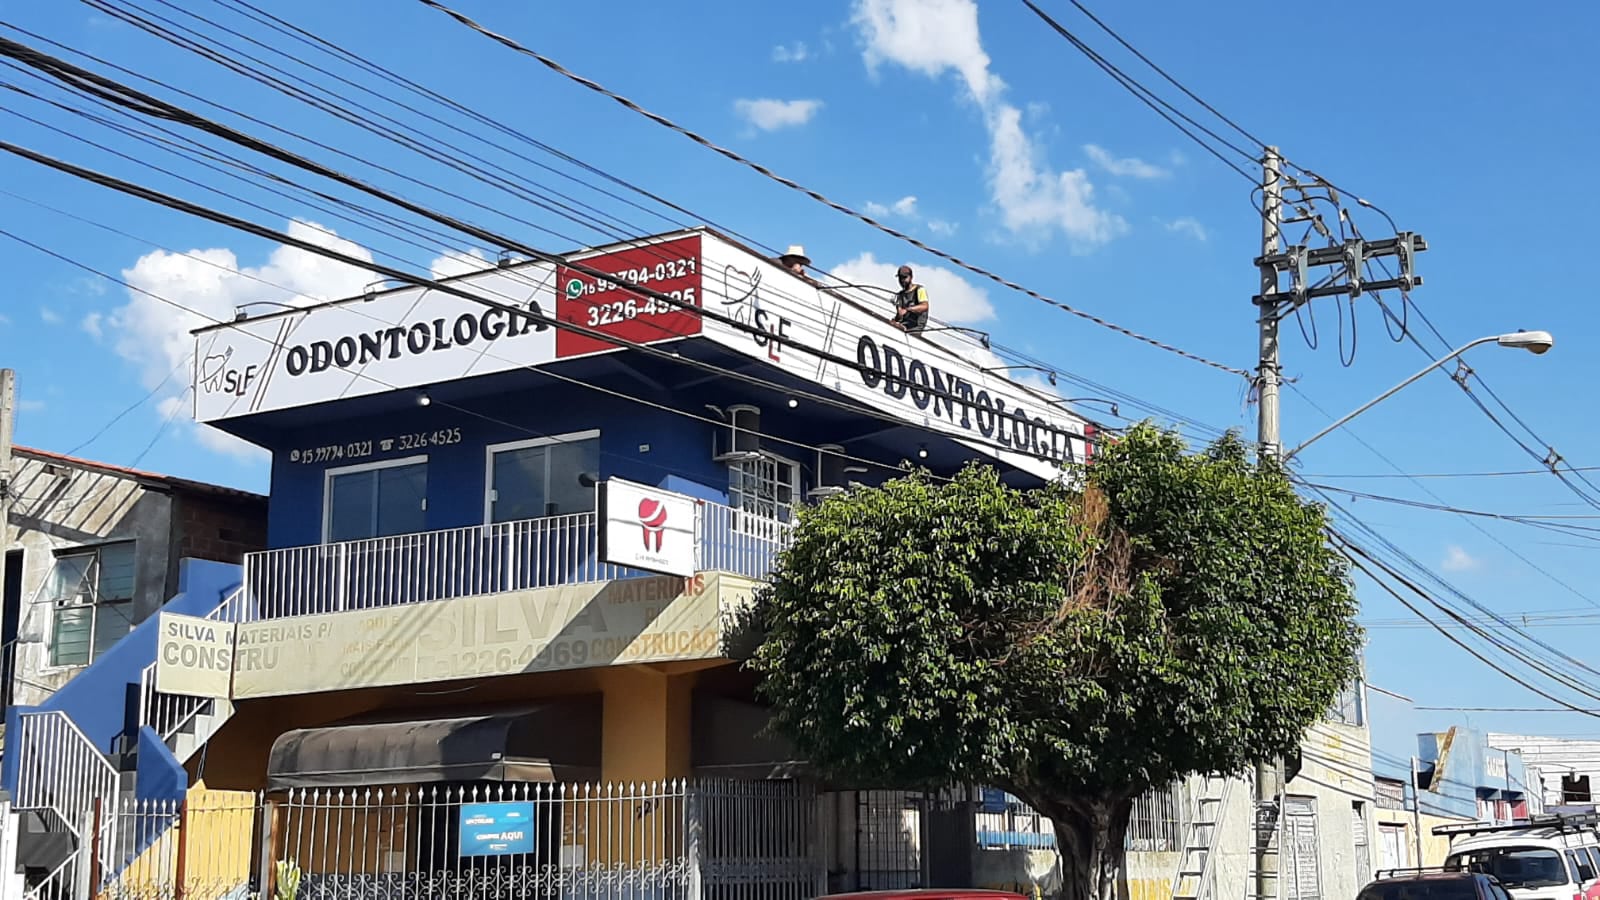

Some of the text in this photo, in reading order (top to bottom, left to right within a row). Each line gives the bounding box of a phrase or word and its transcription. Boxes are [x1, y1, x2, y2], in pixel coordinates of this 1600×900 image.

[584, 283, 596, 295] 15
[285, 300, 550, 377] ODONTOLOGIA
[754, 308, 791, 363] SLF
[223, 365, 257, 397] SLF
[856, 334, 1076, 465] ODONTOLOGIA
[607, 573, 705, 605] MATERIAIS
[417, 584, 608, 650] SILVA
[167, 622, 216, 643] SILVA
[225, 622, 313, 646] MATERIAIS
[163, 641, 280, 672] CONSTRU
[501, 831, 524, 841] AQUI
